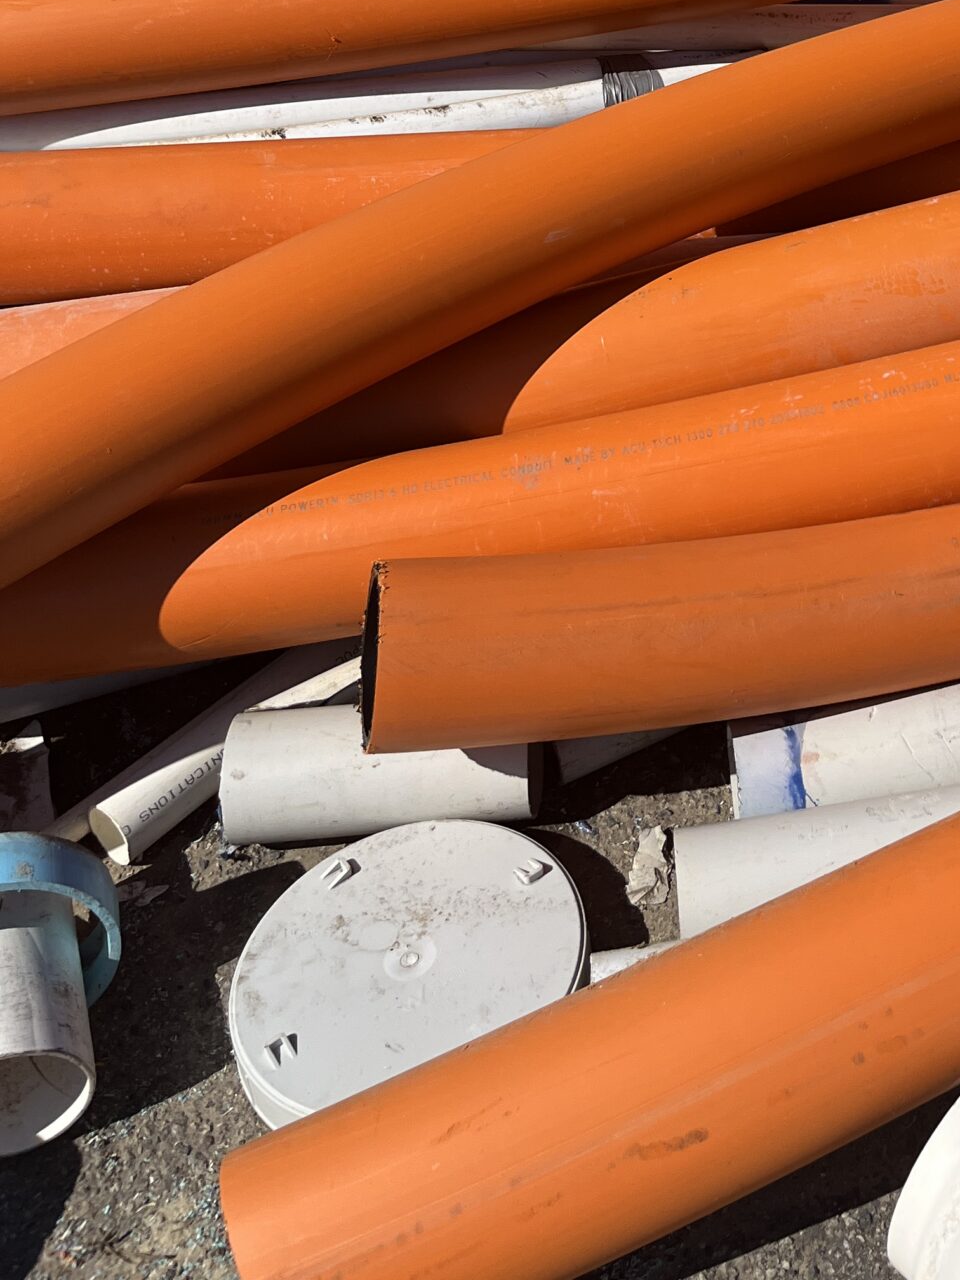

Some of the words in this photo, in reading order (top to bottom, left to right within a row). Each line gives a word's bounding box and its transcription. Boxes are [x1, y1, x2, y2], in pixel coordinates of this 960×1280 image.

[423, 471, 494, 493] ELECTRICAL
[501, 458, 553, 479] CONDUIT
[564, 452, 597, 466] MADE
[600, 447, 616, 461] BY
